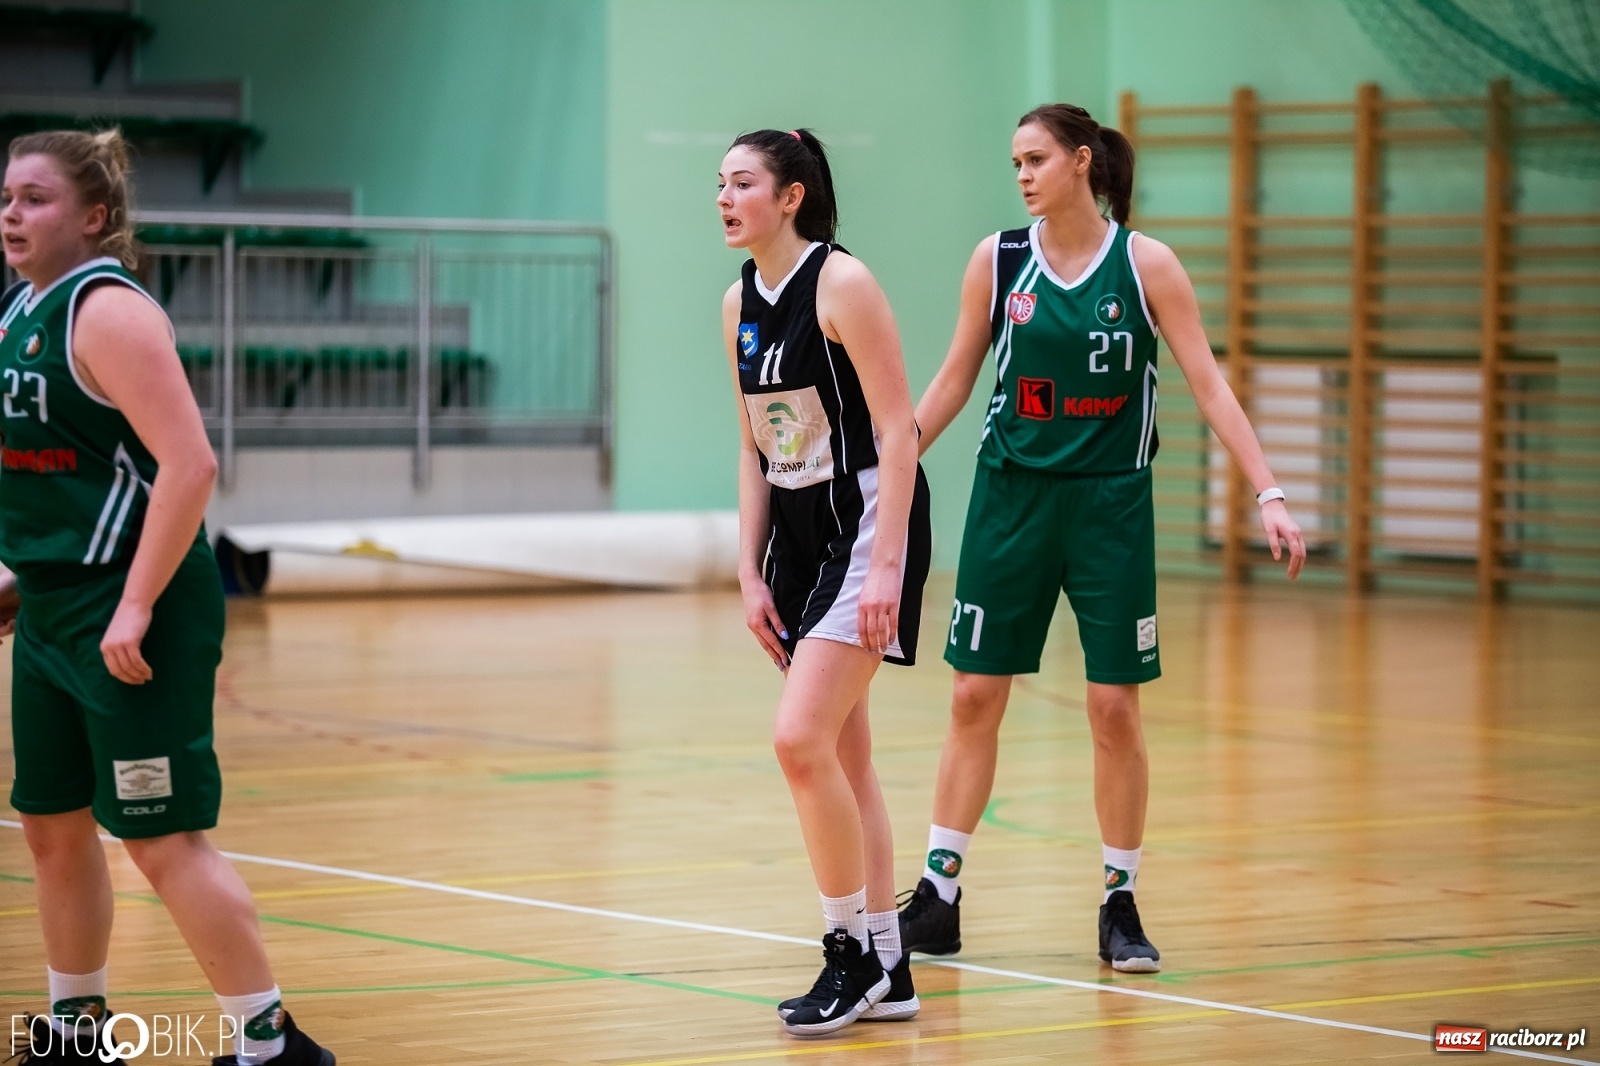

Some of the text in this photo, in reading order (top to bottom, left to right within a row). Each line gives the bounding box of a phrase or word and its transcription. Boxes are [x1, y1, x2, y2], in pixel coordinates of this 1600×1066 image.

[1000, 240, 1030, 249] COLO
[758, 340, 785, 386] 11
[1089, 331, 1133, 373] 27
[3, 368, 48, 423] 27
[1064, 395, 1129, 417] KAMA
[950, 598, 984, 651] 27
[122, 804, 167, 815] COLO
